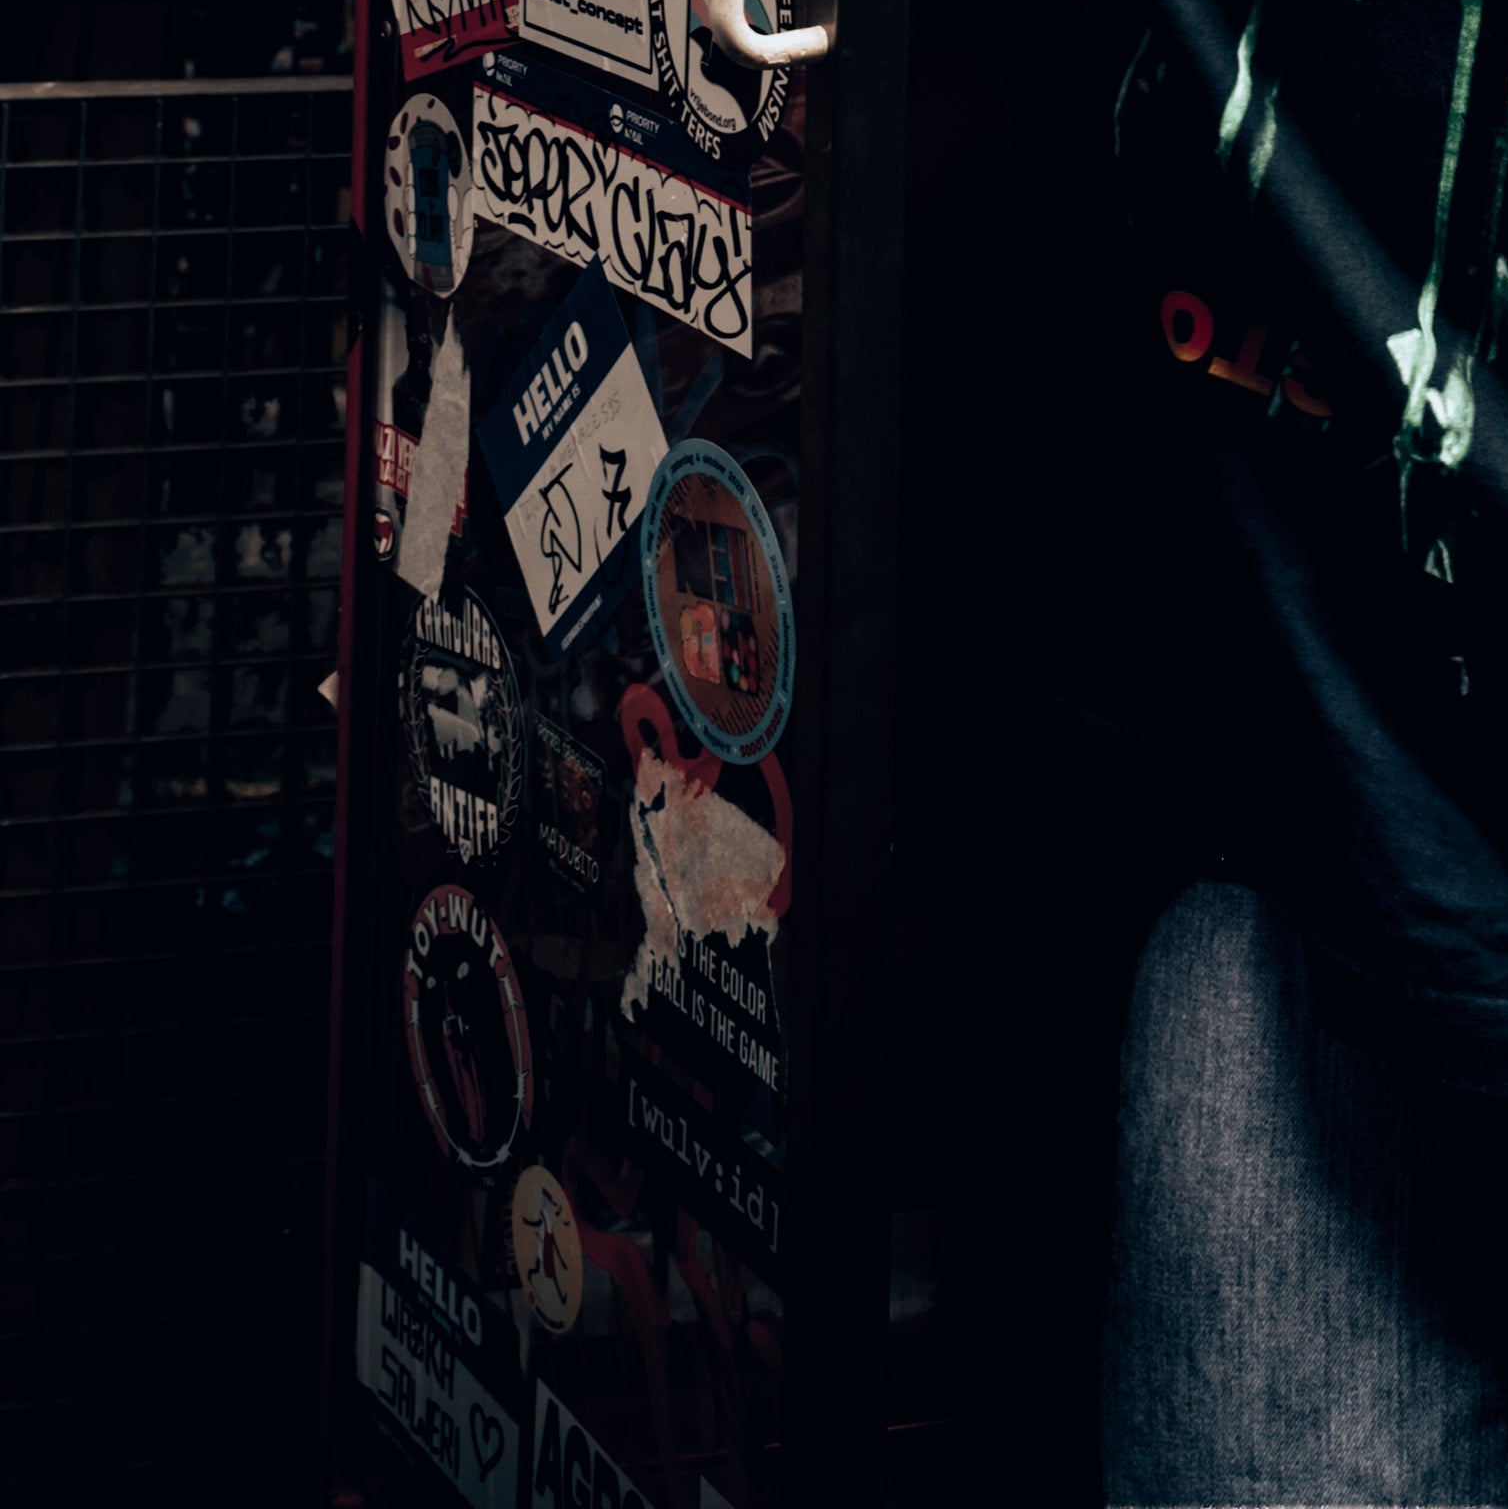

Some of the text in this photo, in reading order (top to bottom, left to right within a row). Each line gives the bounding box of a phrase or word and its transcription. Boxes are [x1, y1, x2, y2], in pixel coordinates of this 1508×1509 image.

[497, 54, 529, 76] PRIORITY
[626, 109, 662, 135] PRIORITY
[680, 98, 723, 162] TERFS
[512, 320, 590, 448] HELLO
[429, 774, 499, 858] ANTIFA
[690, 933, 717, 984] THE
[721, 959, 767, 1026] COLOR
[692, 989, 706, 1028] IS
[709, 1003, 737, 1056] THE
[739, 1030, 781, 1094] GAME
[400, 1228, 483, 1347] HELLO
